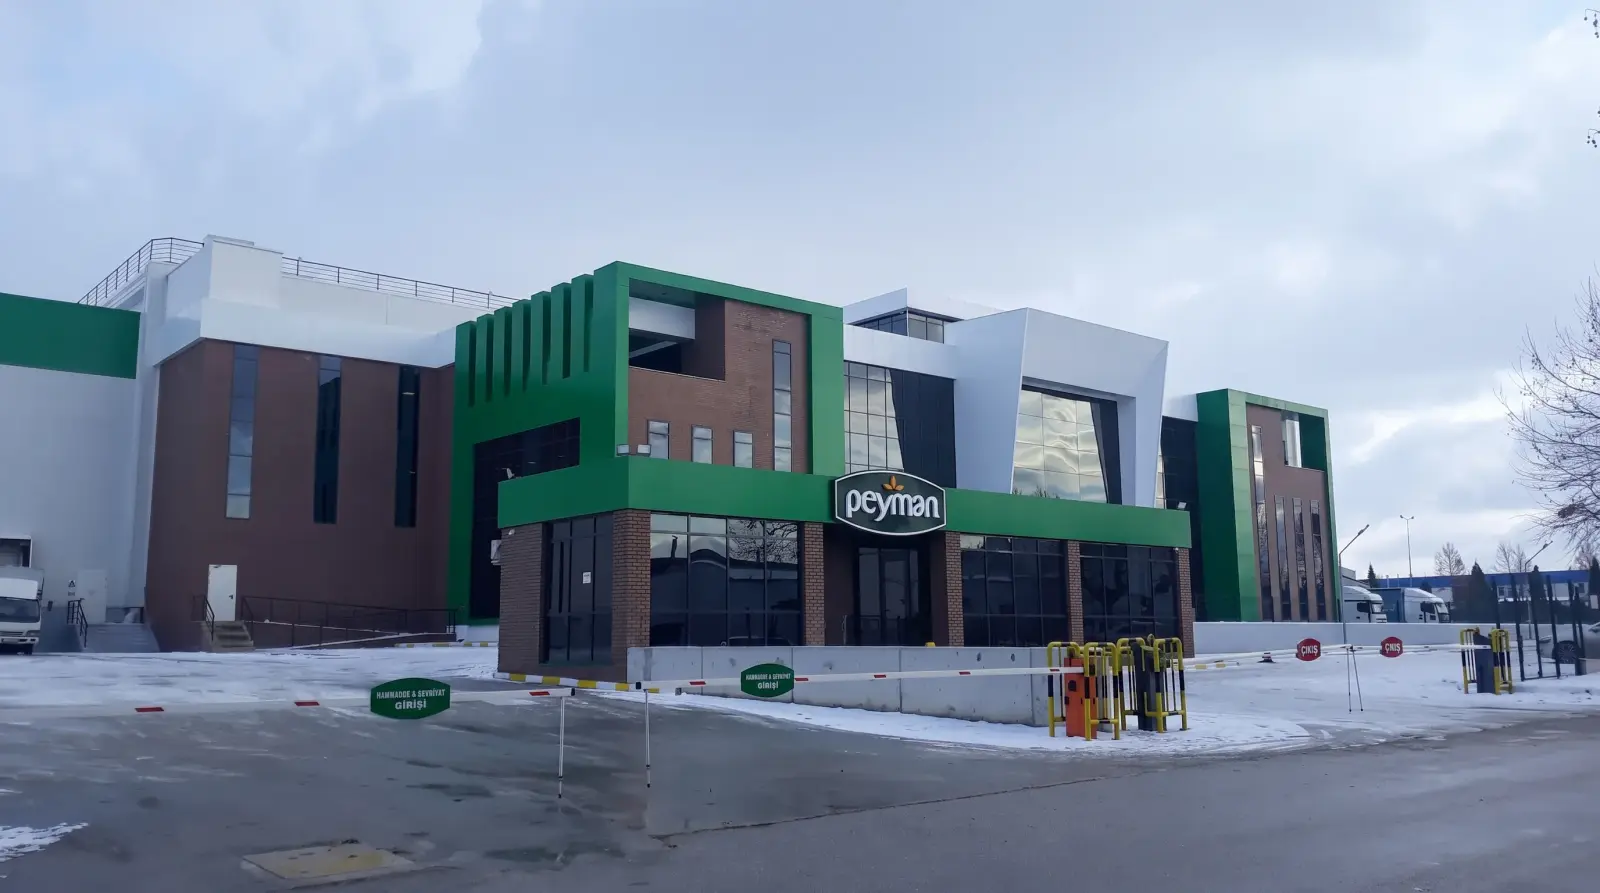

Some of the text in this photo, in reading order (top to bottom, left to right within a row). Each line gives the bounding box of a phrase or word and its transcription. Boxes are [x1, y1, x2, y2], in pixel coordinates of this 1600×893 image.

[845, 489, 940, 521] peyman
[1301, 644, 1318, 657] ÇIKIŞ
[376, 690, 410, 699] HAMMADDE
[412, 690, 416, 698] &
[395, 699, 427, 710] GİRİŞİ
